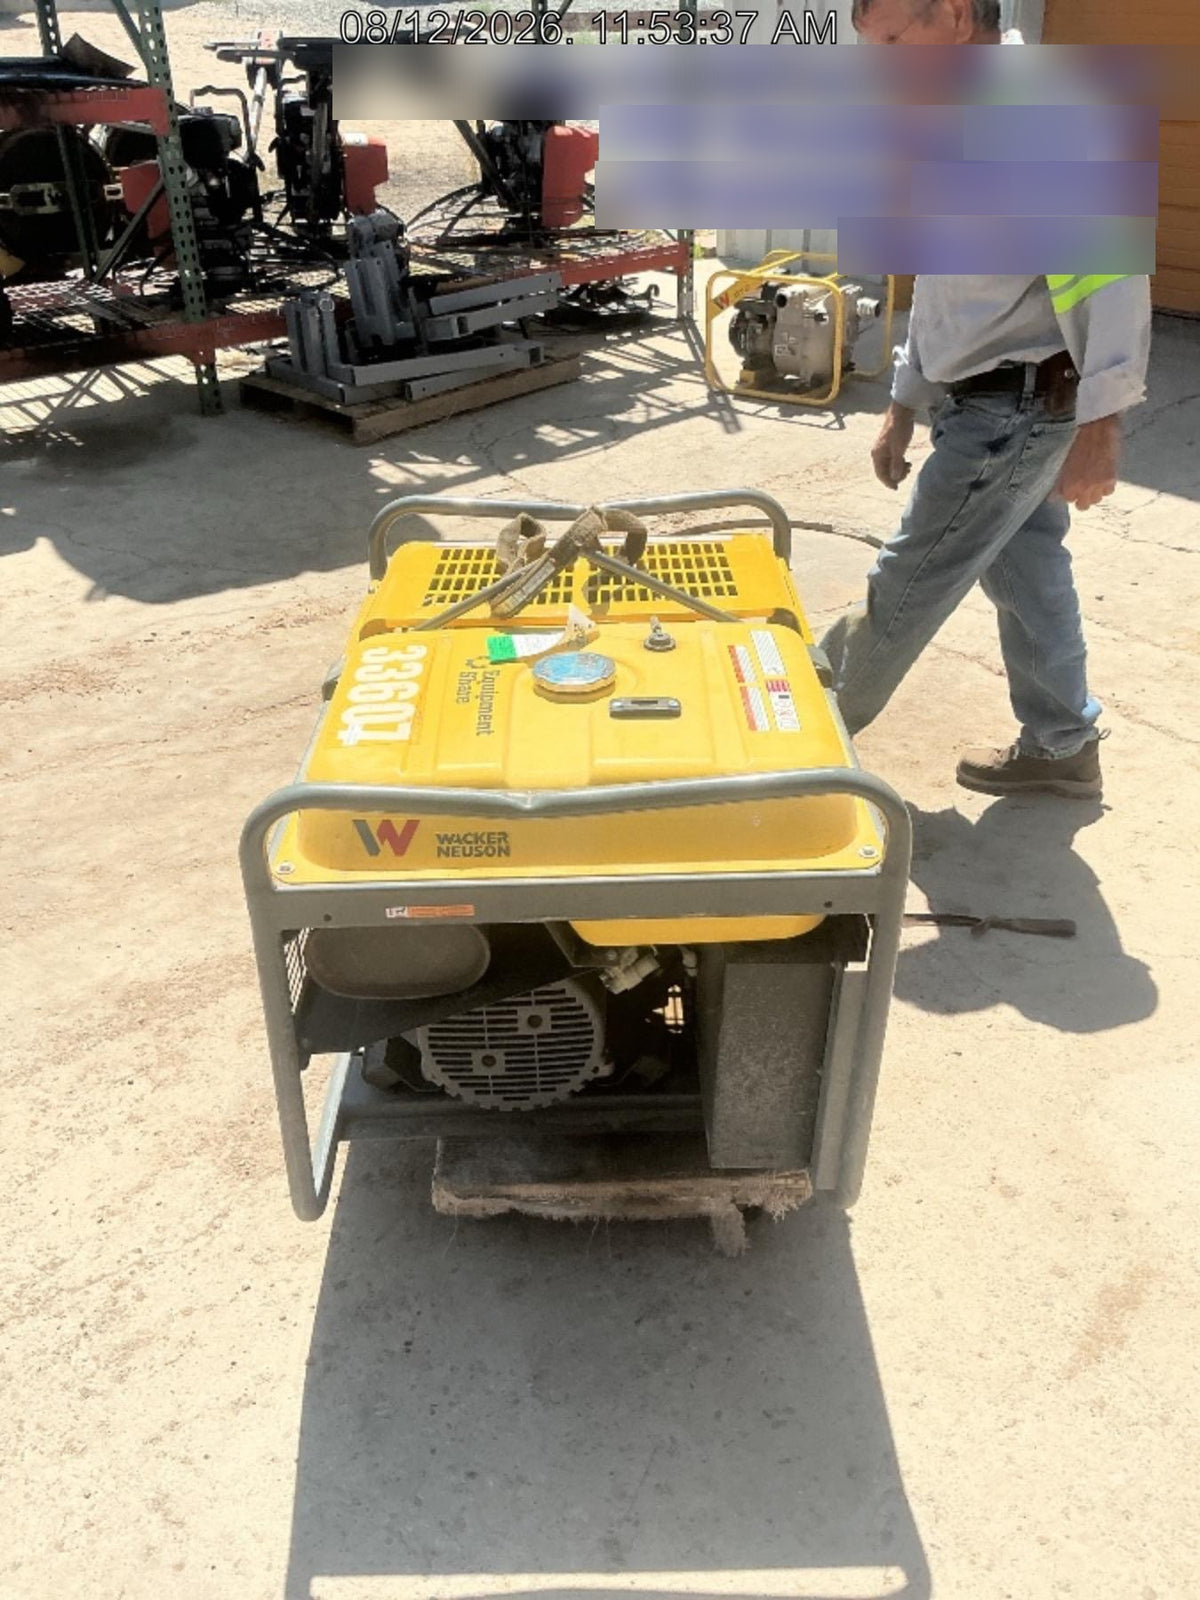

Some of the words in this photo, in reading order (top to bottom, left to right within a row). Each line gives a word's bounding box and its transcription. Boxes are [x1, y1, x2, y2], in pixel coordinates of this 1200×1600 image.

[456, 671, 478, 704] Share
[475, 670, 500, 736] Equipment
[435, 832, 510, 846] WACKER
[436, 845, 511, 858] NEUSON
